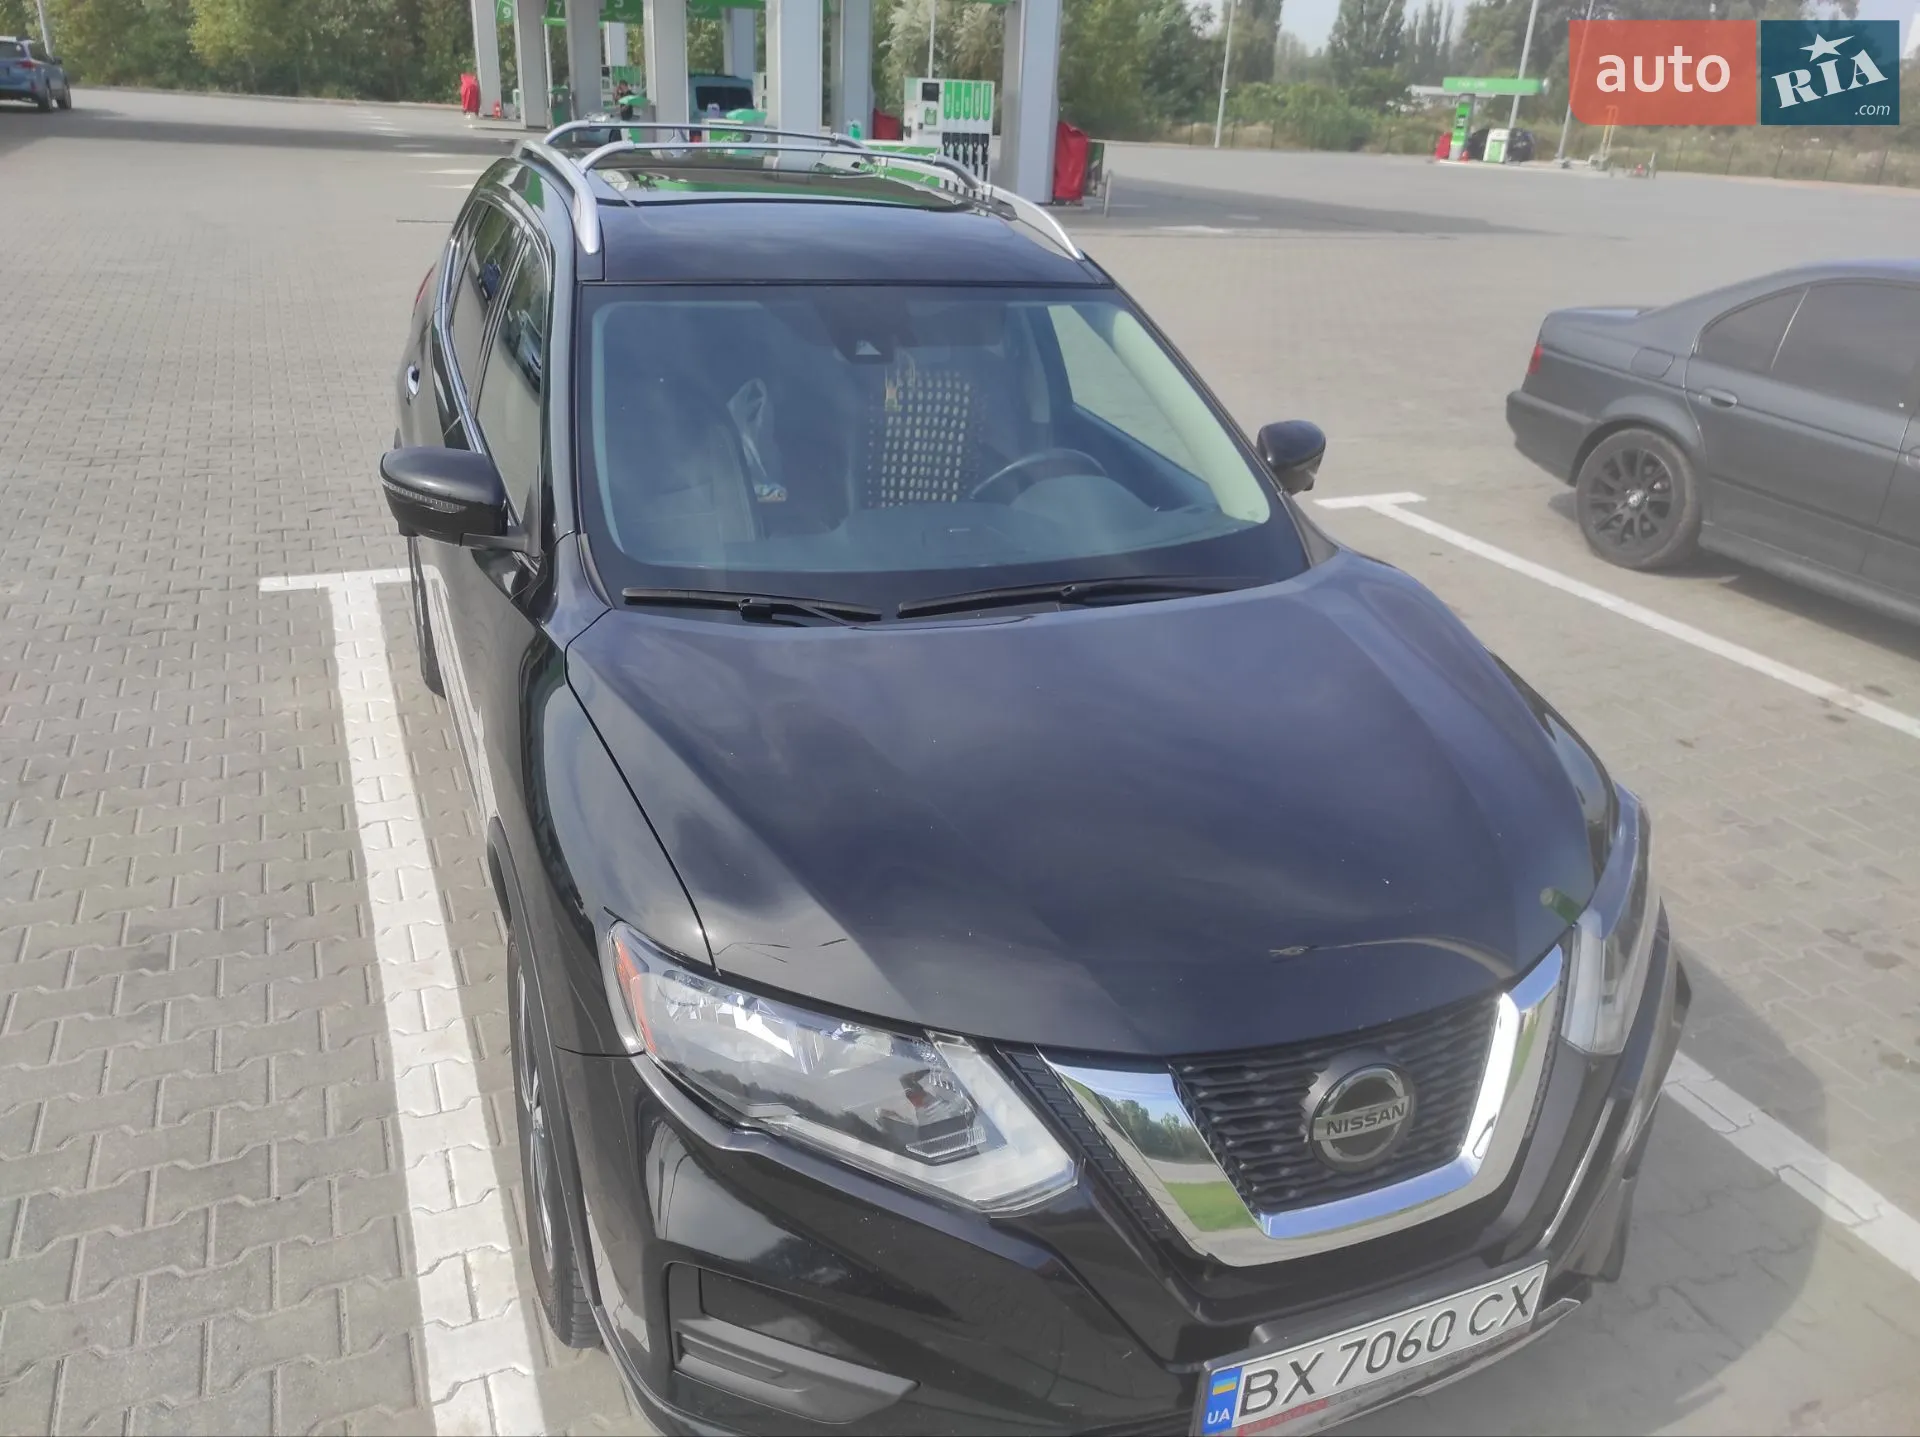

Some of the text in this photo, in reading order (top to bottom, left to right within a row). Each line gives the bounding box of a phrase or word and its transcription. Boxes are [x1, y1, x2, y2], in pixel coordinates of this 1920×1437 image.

[1326, 1103, 1405, 1136] NISSAN
[1239, 1352, 1325, 1418] BX
[1333, 1309, 1457, 1387] 7060
[1468, 1275, 1539, 1336] CX
[1207, 1408, 1231, 1425] UA
